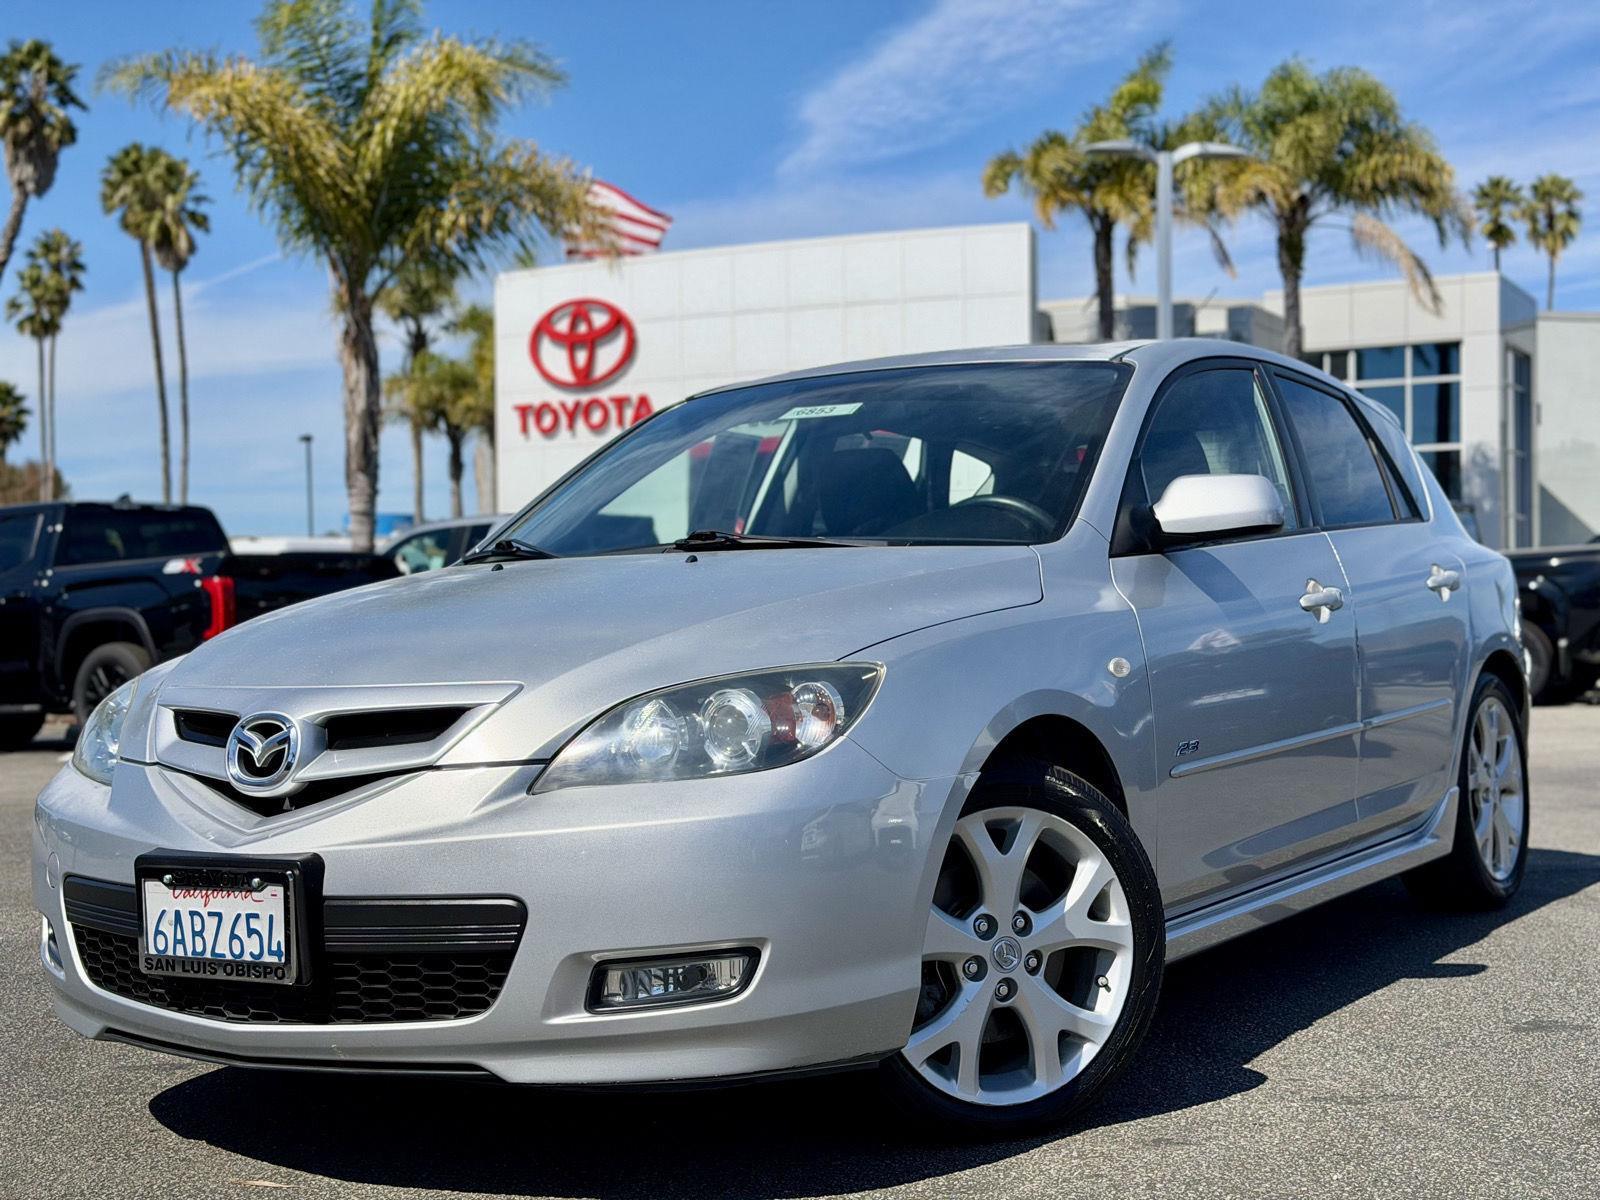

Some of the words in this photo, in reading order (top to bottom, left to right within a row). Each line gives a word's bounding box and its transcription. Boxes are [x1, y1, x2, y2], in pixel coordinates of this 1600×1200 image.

[512, 394, 653, 436] TOYOTA
[153, 908, 284, 963] 6ABZ654
[144, 957, 176, 973] SAN
[181, 959, 218, 976] LUIS
[223, 962, 286, 981] OBISPO
